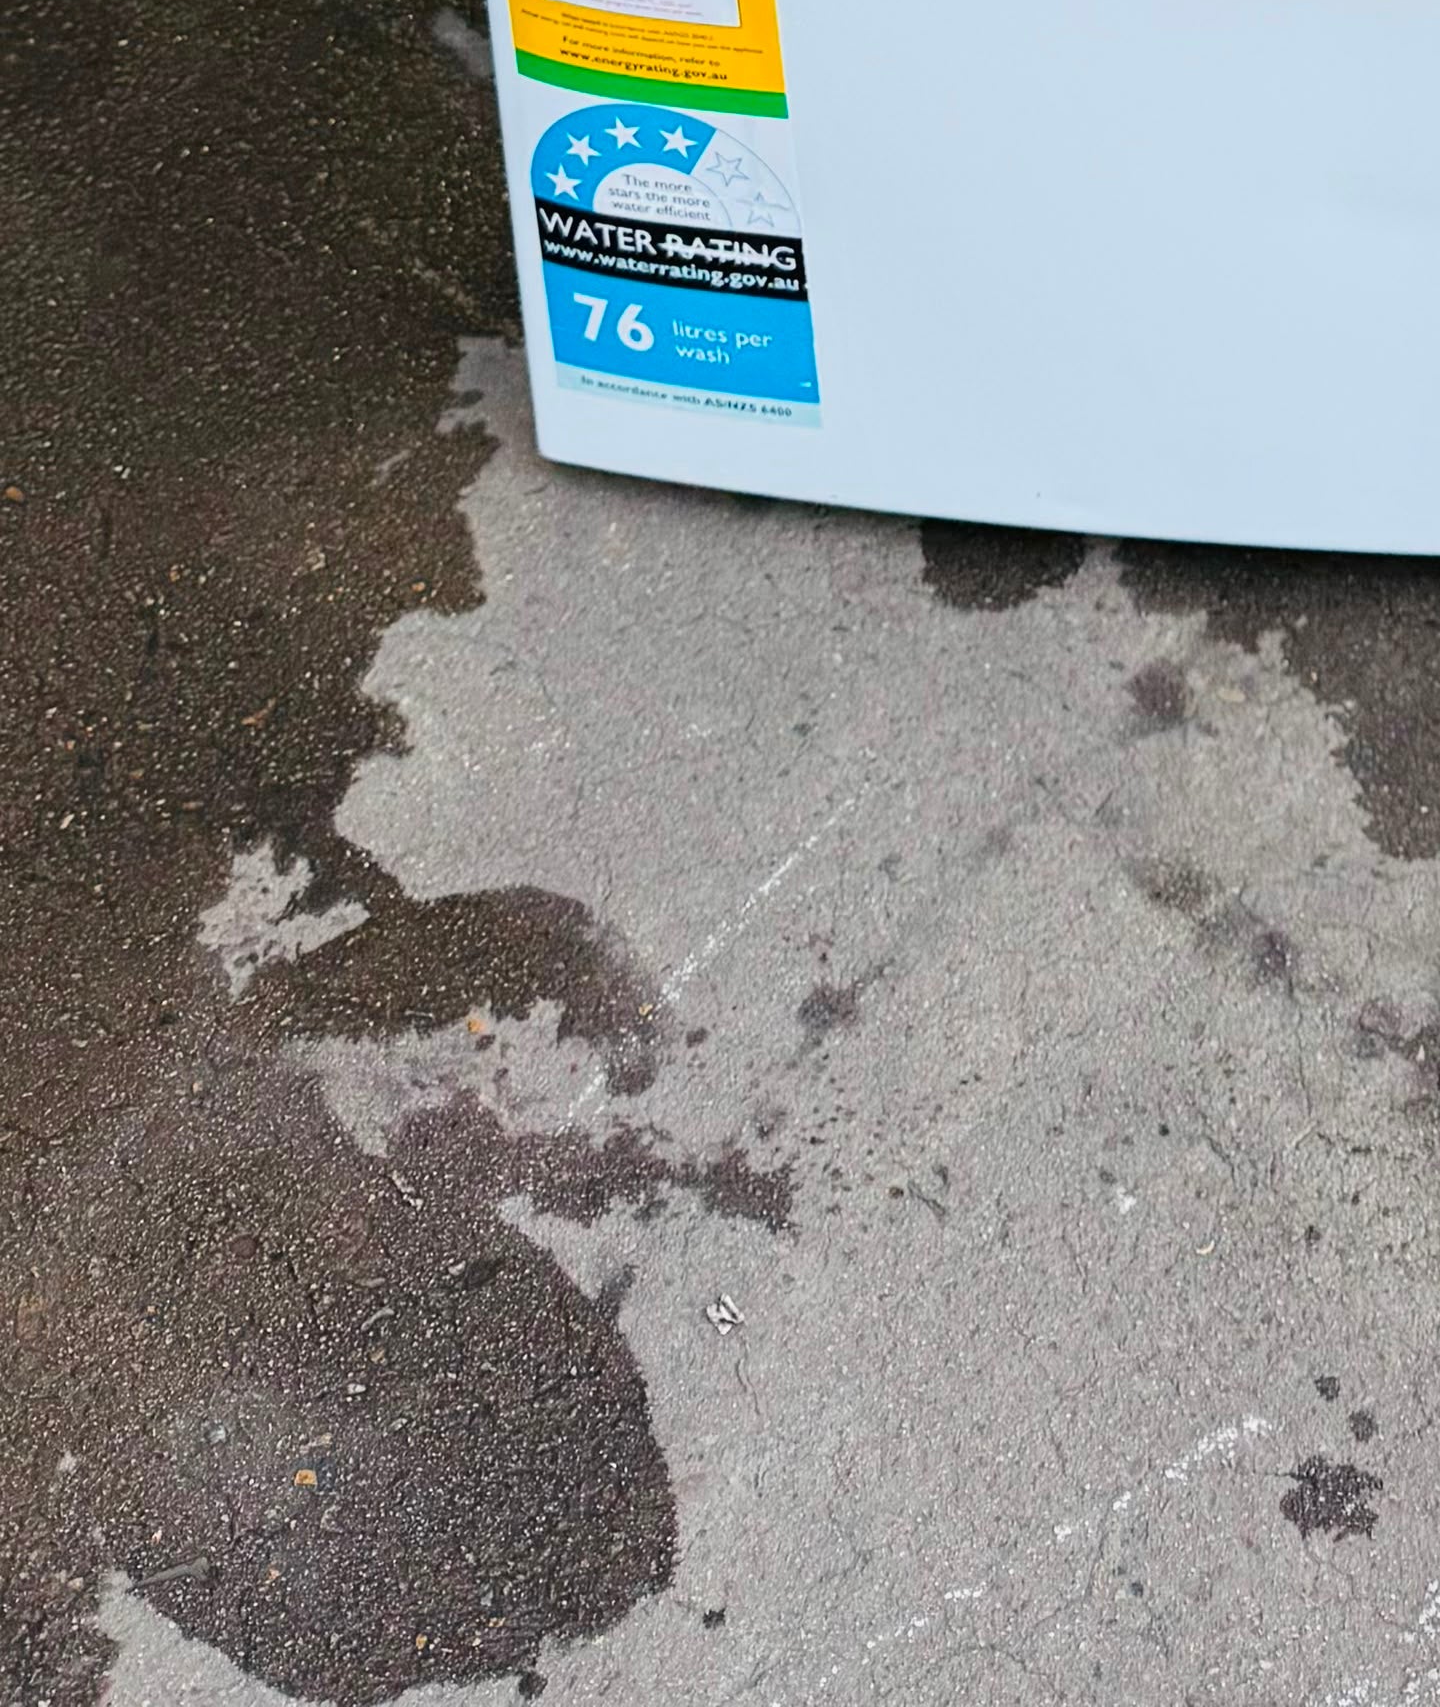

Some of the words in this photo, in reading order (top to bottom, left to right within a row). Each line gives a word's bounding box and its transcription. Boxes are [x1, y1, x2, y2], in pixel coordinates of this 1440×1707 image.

[560, 47, 729, 81] www.energyrating.gov.au
[562, 35, 579, 46] For
[582, 40, 611, 52] more
[680, 56, 705, 67] refer
[709, 60, 721, 68] to
[608, 186, 640, 200] stars
[645, 191, 668, 204] the
[672, 197, 710, 209] more
[621, 174, 650, 188] The
[654, 180, 692, 193] more
[612, 200, 651, 214] water
[655, 205, 711, 221] efficient
[539, 207, 657, 256] WATER
[663, 232, 797, 272] RATING
[543, 239, 799, 292] www.waterrating.gov.au
[573, 292, 655, 352] 76
[672, 319, 728, 344] litres
[735, 331, 773, 349] per
[676, 344, 730, 364] wash
[673, 393, 701, 406] with
